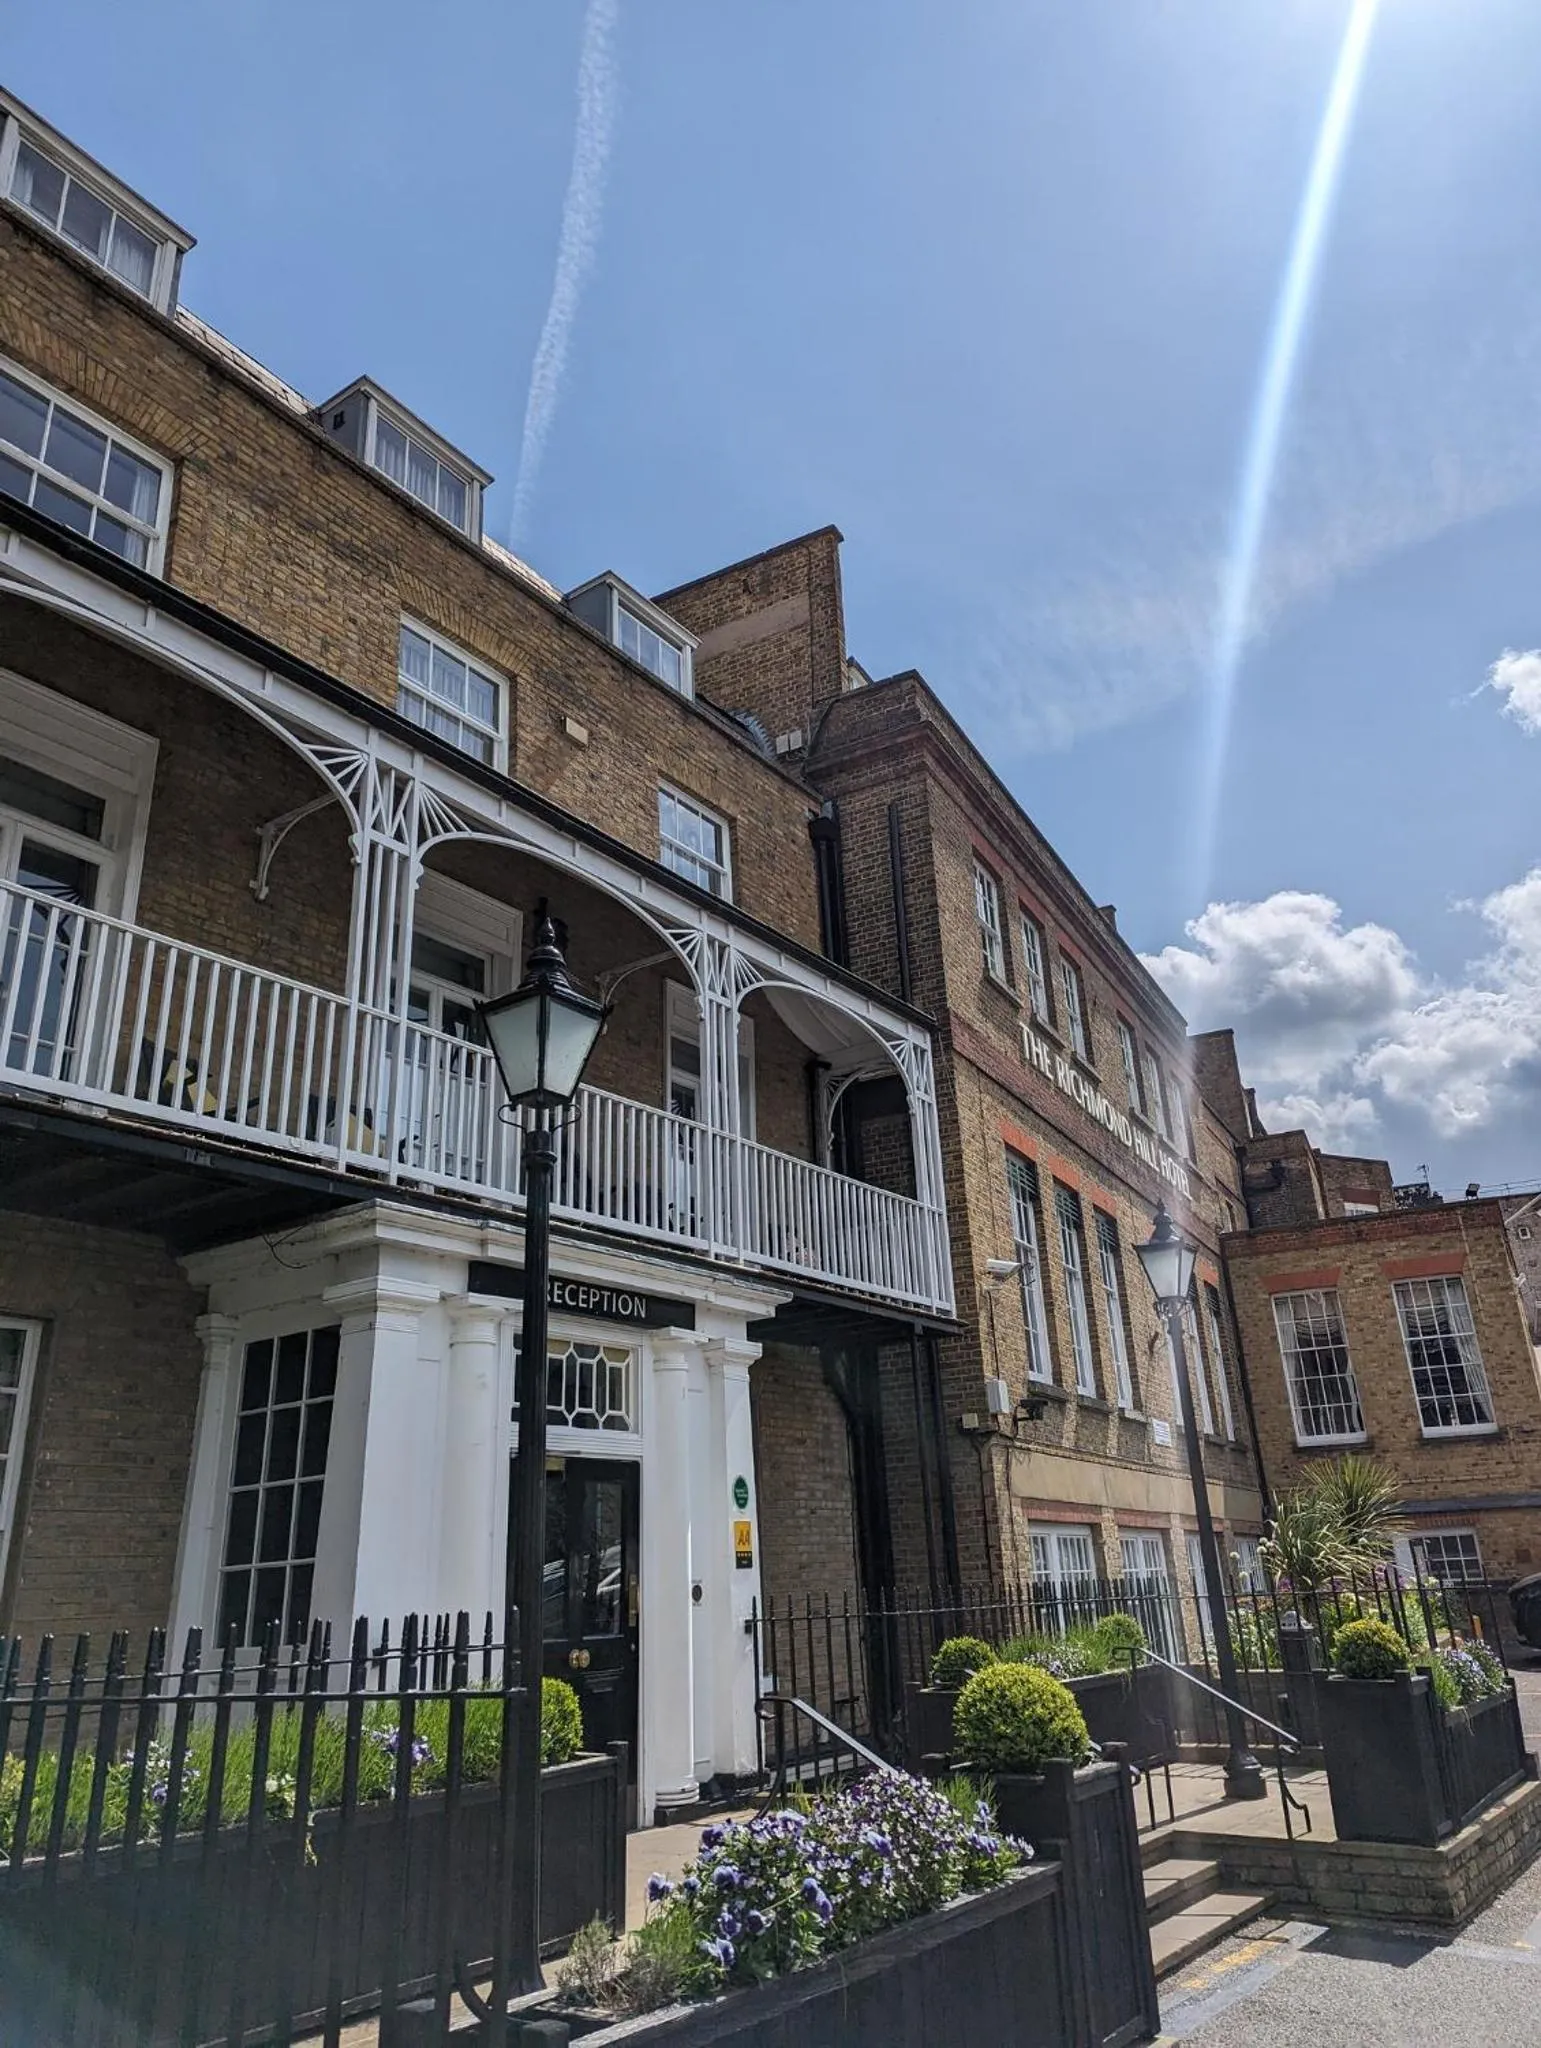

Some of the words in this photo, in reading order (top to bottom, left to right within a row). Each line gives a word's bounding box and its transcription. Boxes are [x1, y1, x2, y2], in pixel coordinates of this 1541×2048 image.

[1019, 1021, 1054, 1080] THE
[1055, 1053, 1132, 1147] RICHMOND
[1133, 1126, 1160, 1172] HILL
[1159, 1149, 1193, 1200] HOTEL
